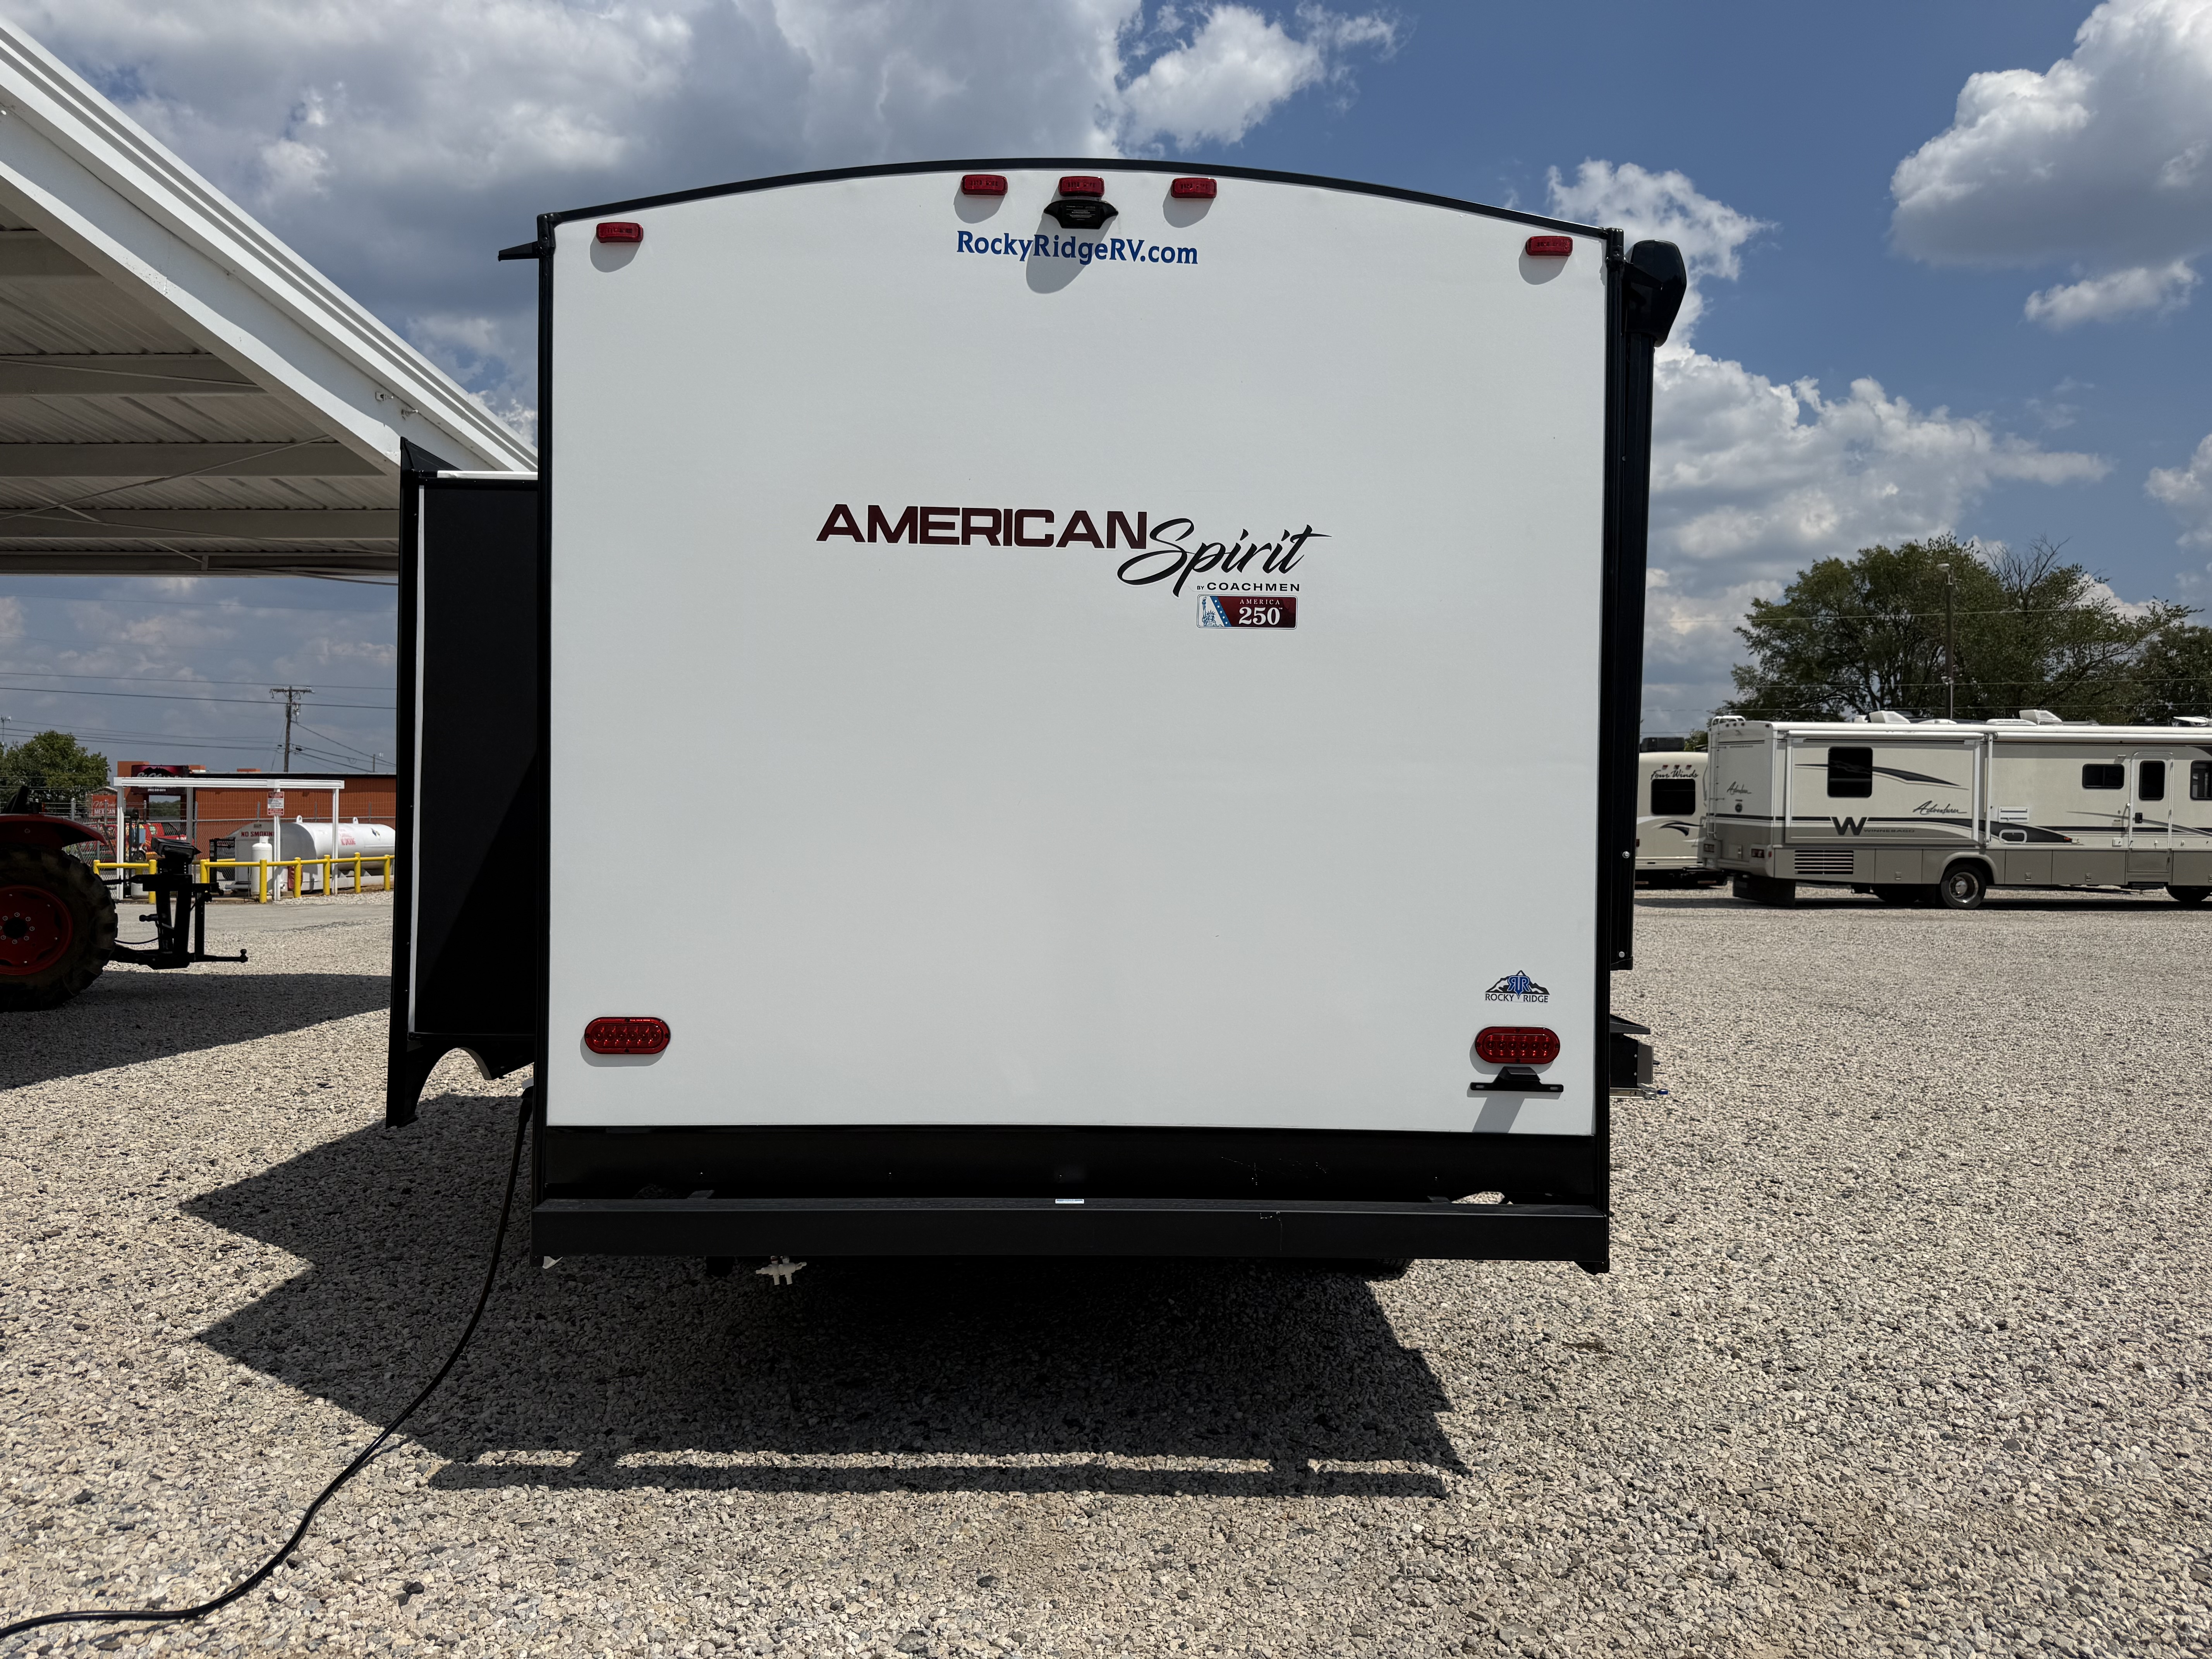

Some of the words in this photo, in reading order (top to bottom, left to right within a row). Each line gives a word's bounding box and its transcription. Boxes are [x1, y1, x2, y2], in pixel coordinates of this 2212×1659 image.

[957, 231, 1198, 265] RockyRidgeRV.com
[816, 504, 1147, 549] AMERICAN
[1117, 518, 1331, 597] Spirit
[1207, 582, 1300, 591] COACHMEN
[1650, 769, 1669, 780] Four
[1671, 769, 1699, 778] Winds
[1912, 800, 1967, 815] Adventurer
[1485, 993, 1515, 1001] ROCKY
[1523, 994, 1549, 1003] RIDGE
